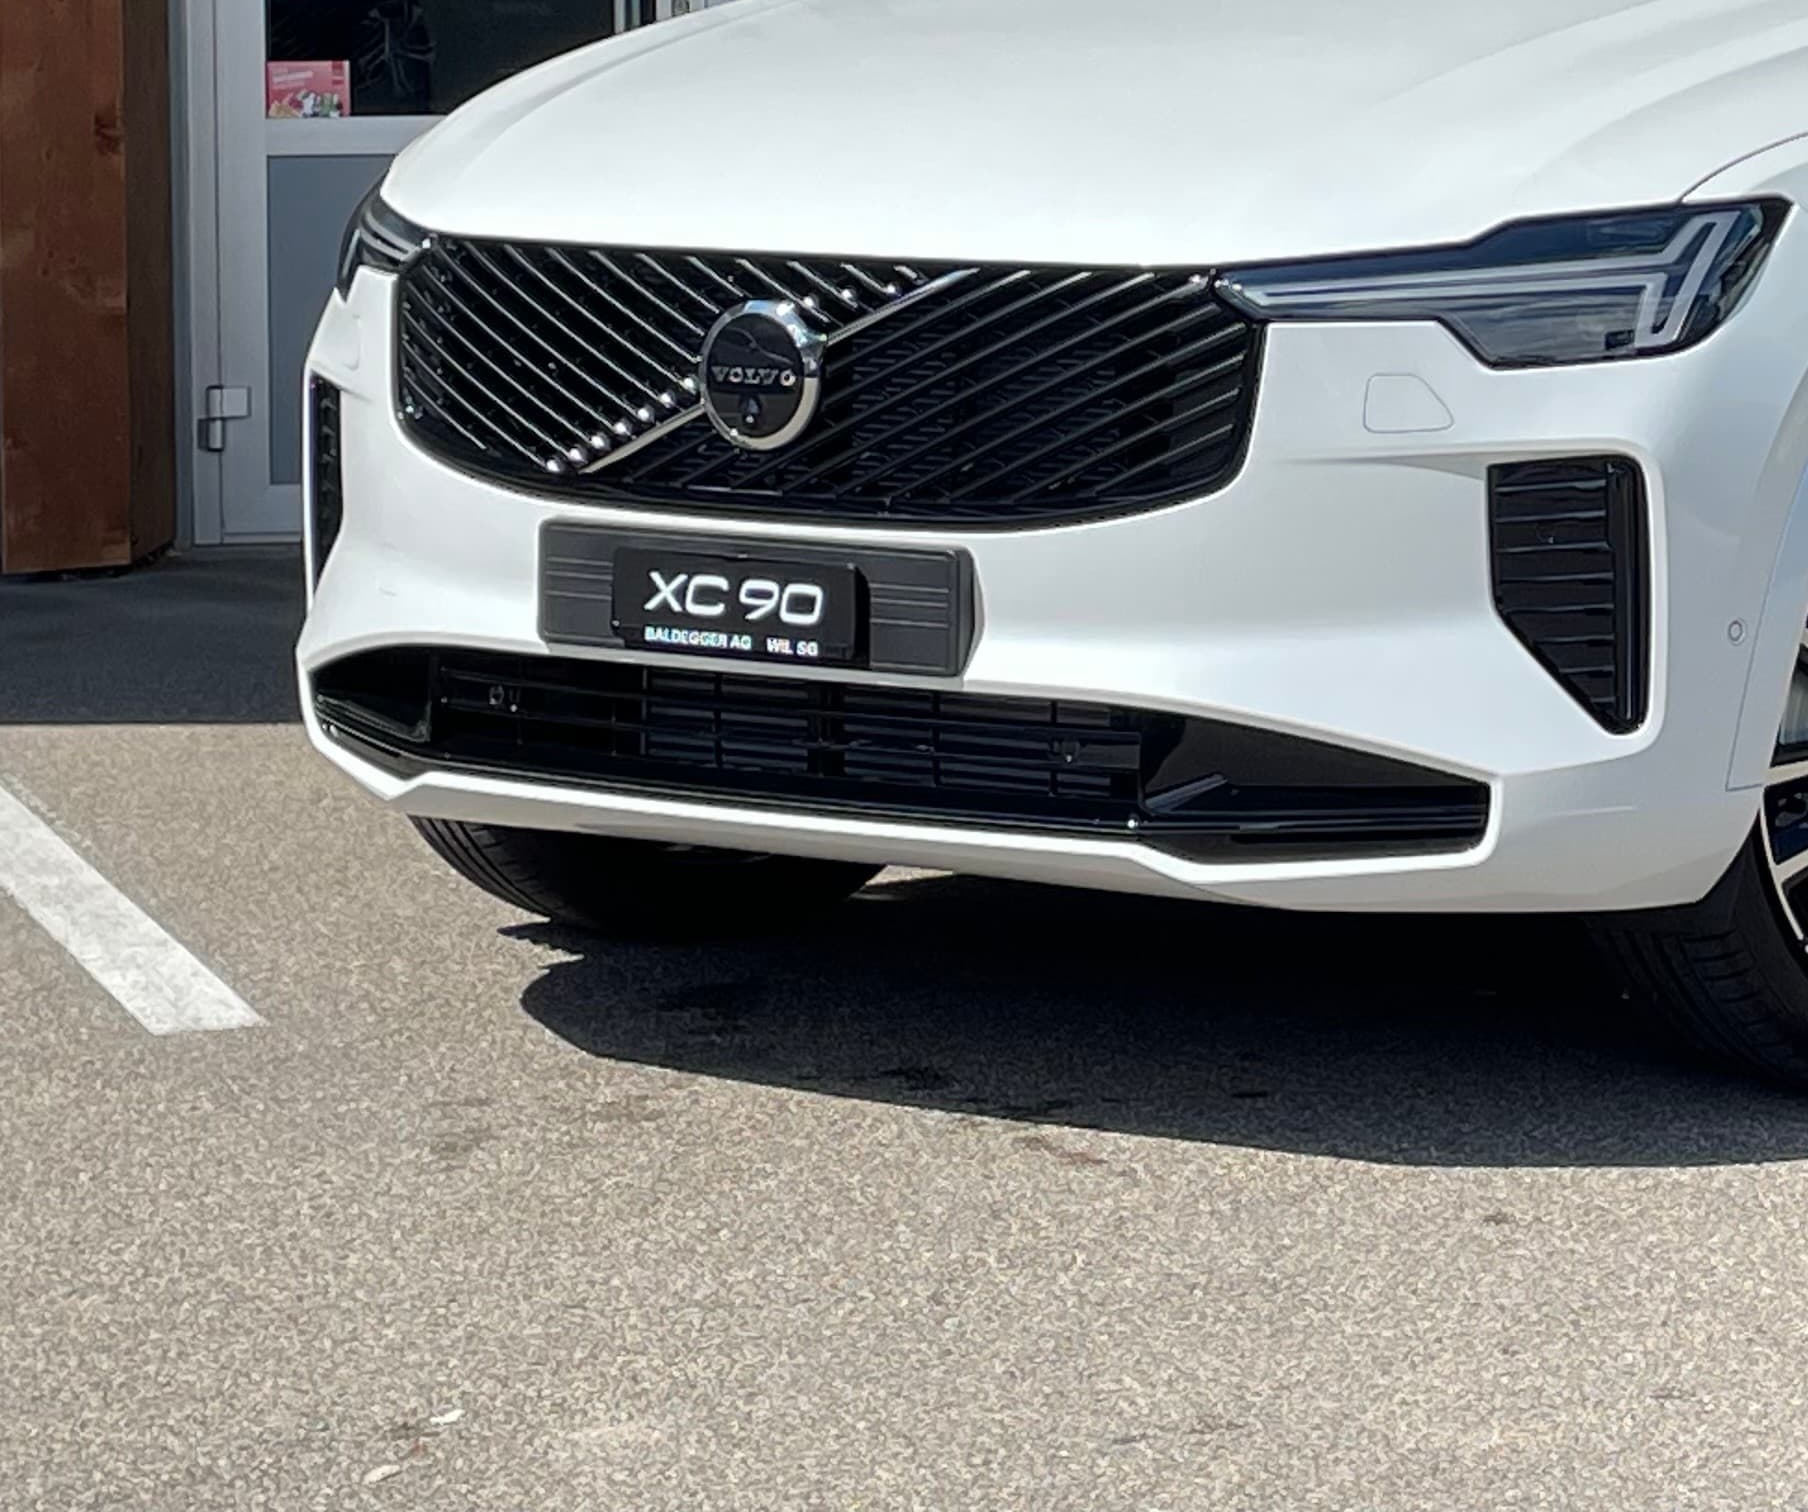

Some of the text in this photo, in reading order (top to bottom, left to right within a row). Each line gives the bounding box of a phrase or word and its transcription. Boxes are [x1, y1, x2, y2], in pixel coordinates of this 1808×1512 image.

[711, 366, 797, 387] VOLVO
[643, 570, 825, 626] XC 90
[644, 626, 819, 657] BALDEGGER AG WIL SG
